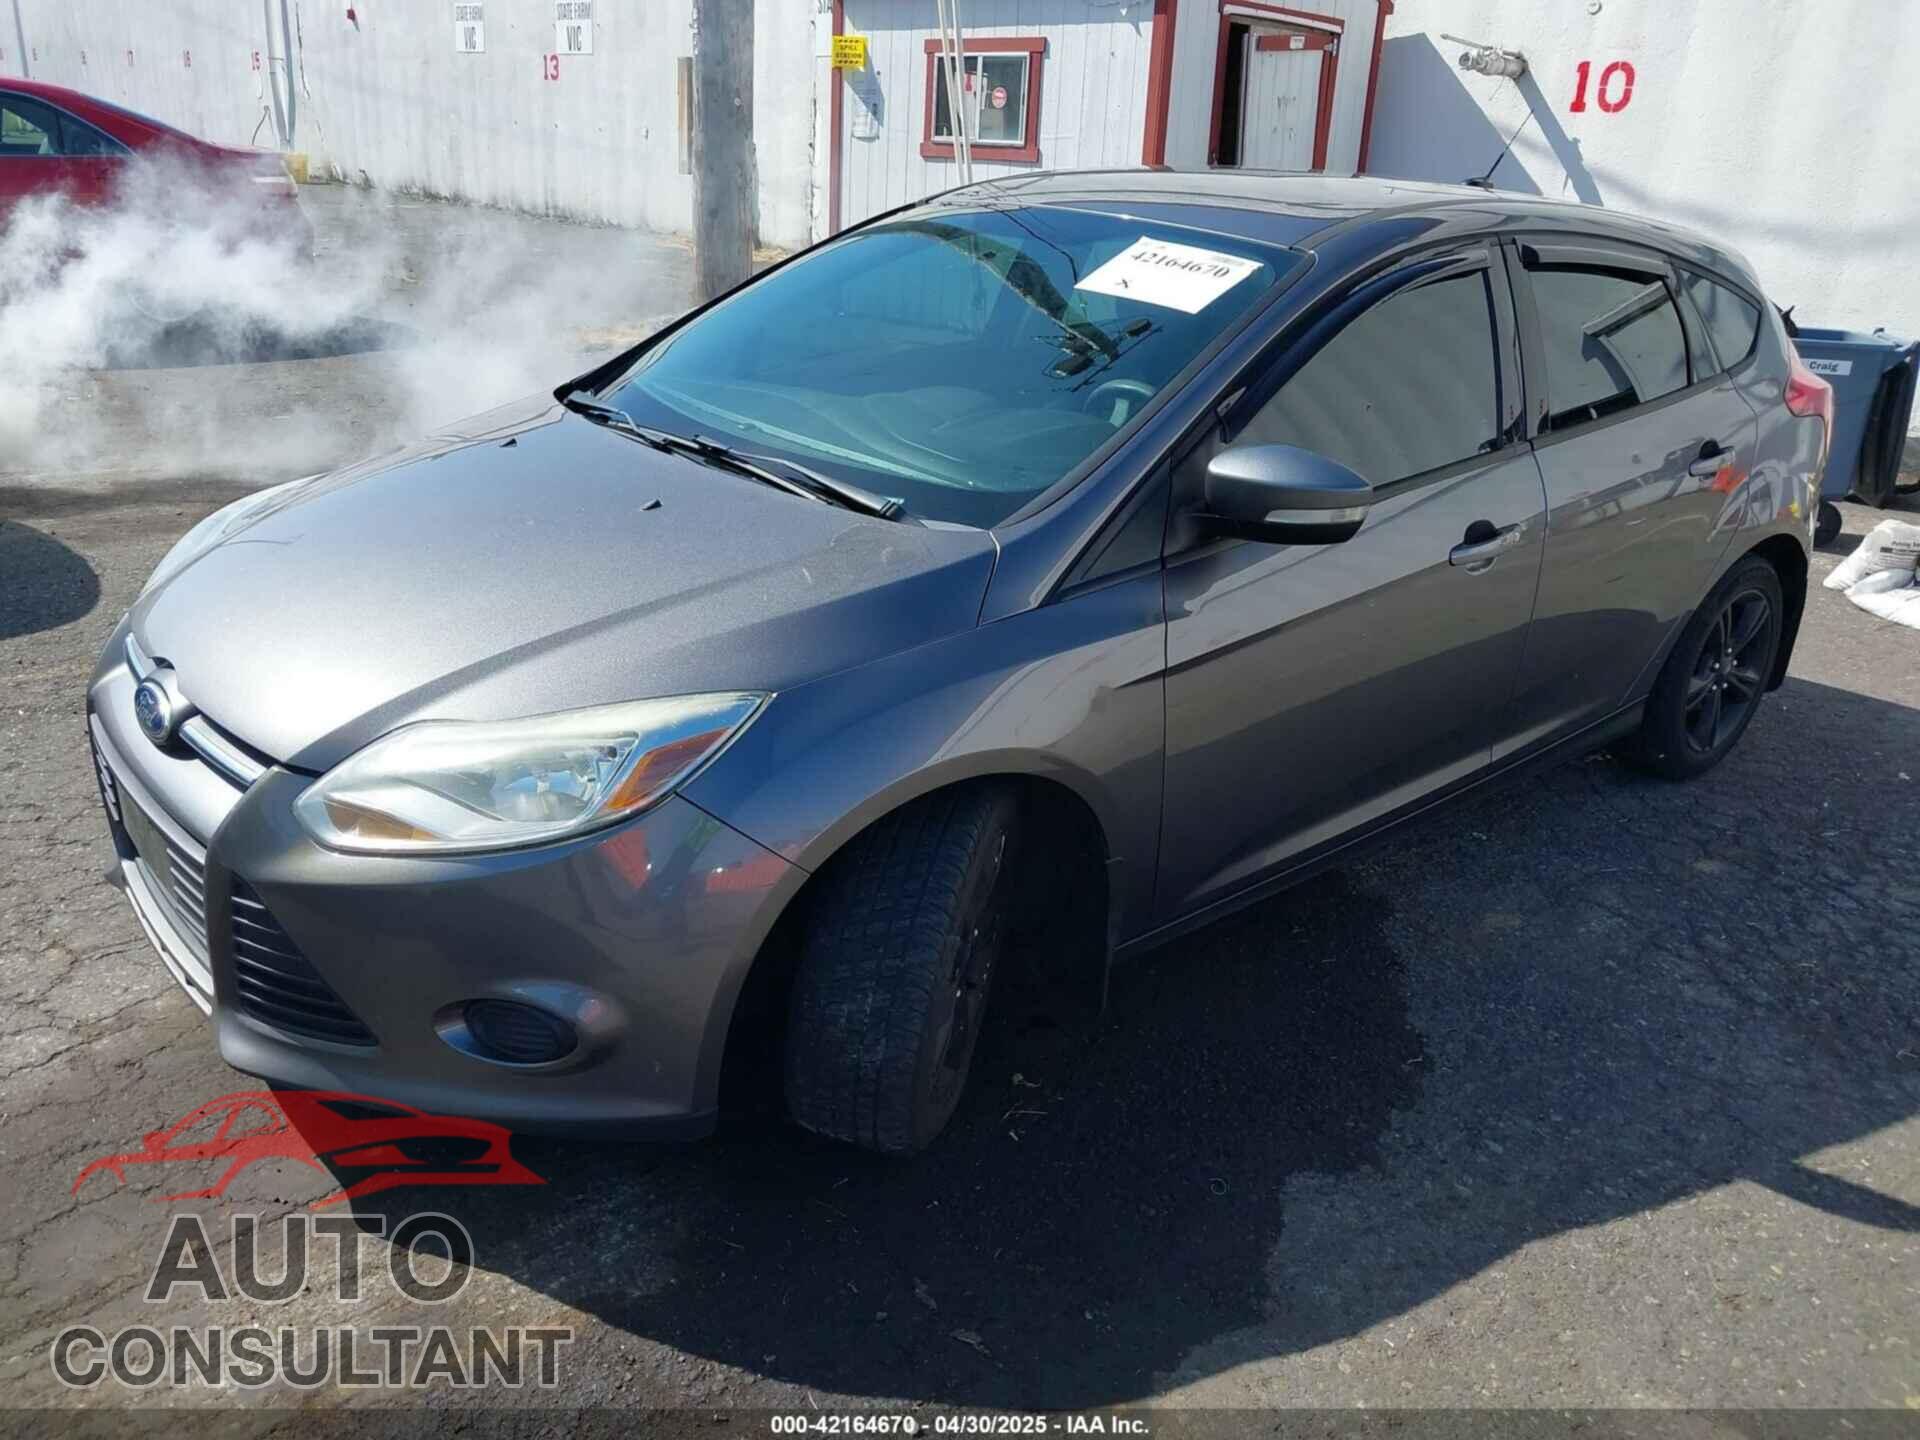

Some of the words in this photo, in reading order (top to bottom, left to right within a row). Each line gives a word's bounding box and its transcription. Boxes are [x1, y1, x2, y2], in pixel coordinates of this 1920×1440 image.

[464, 26, 477, 50] VIC
[566, 26, 582, 51] VIC
[543, 54, 560, 81] 13
[1569, 60, 1636, 113] 10
[1131, 250, 1231, 278] 42164670
[1809, 361, 1839, 372] Craig
